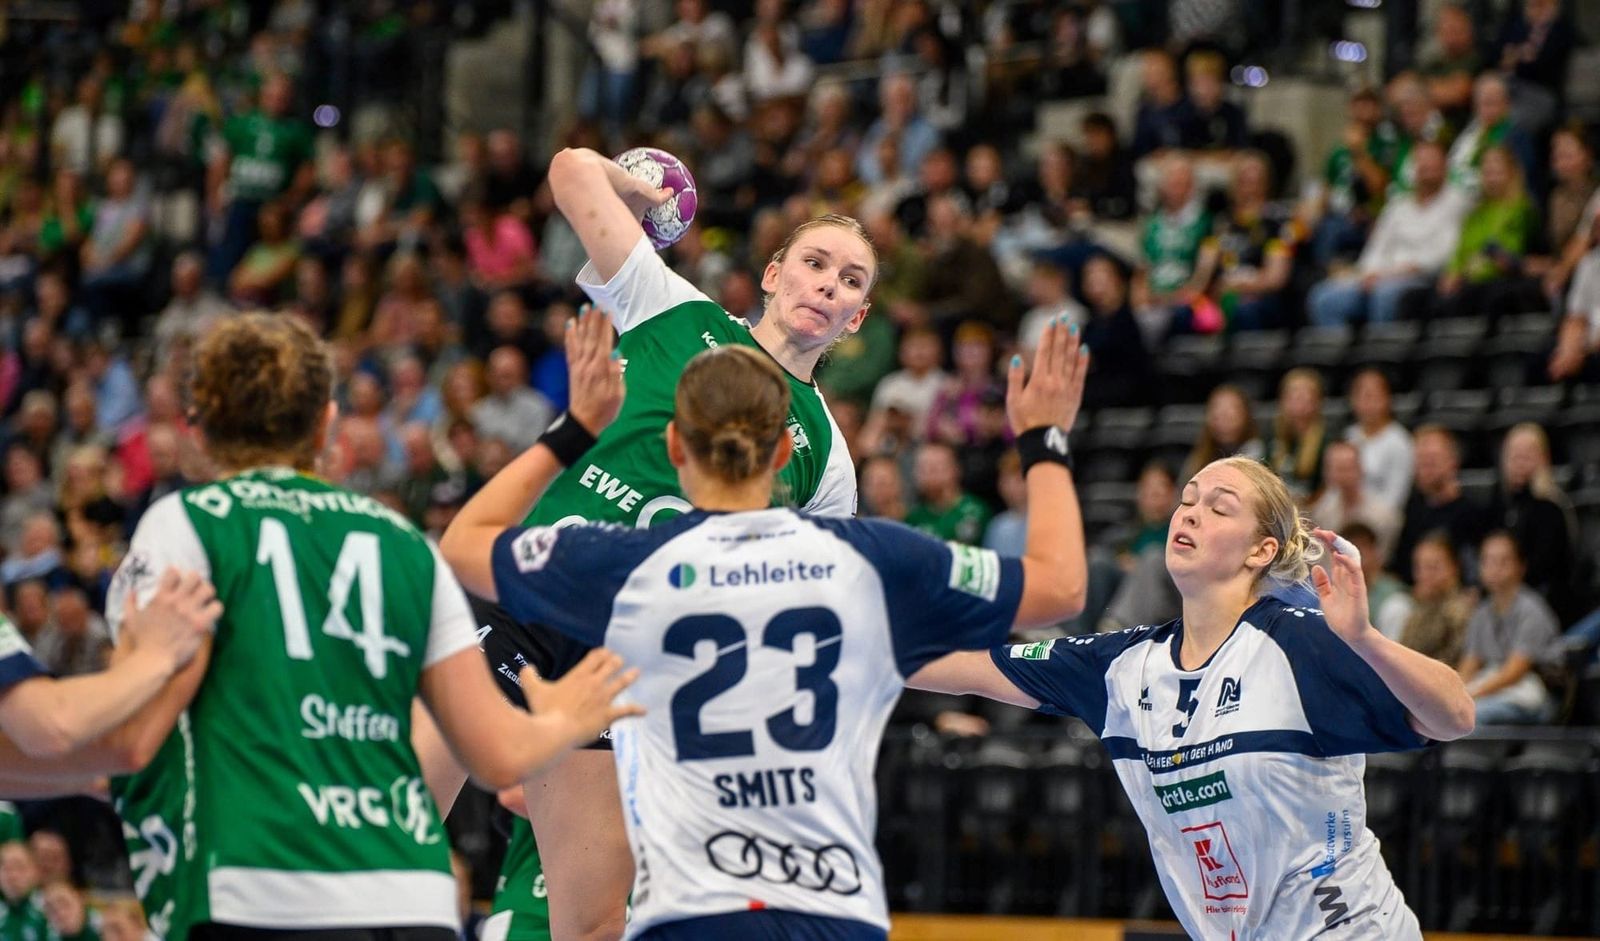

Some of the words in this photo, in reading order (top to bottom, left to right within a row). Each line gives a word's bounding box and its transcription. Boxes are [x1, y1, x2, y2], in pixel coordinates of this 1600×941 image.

[578, 463, 643, 513] EWE
[256, 516, 410, 679] 14
[709, 560, 836, 587] Lehleiter
[662, 606, 842, 763] 23
[1172, 678, 1200, 738] 5
[713, 768, 816, 808] SMITS
[1324, 811, 1336, 866] tadtwerke
[1341, 808, 1353, 854] karsulm
